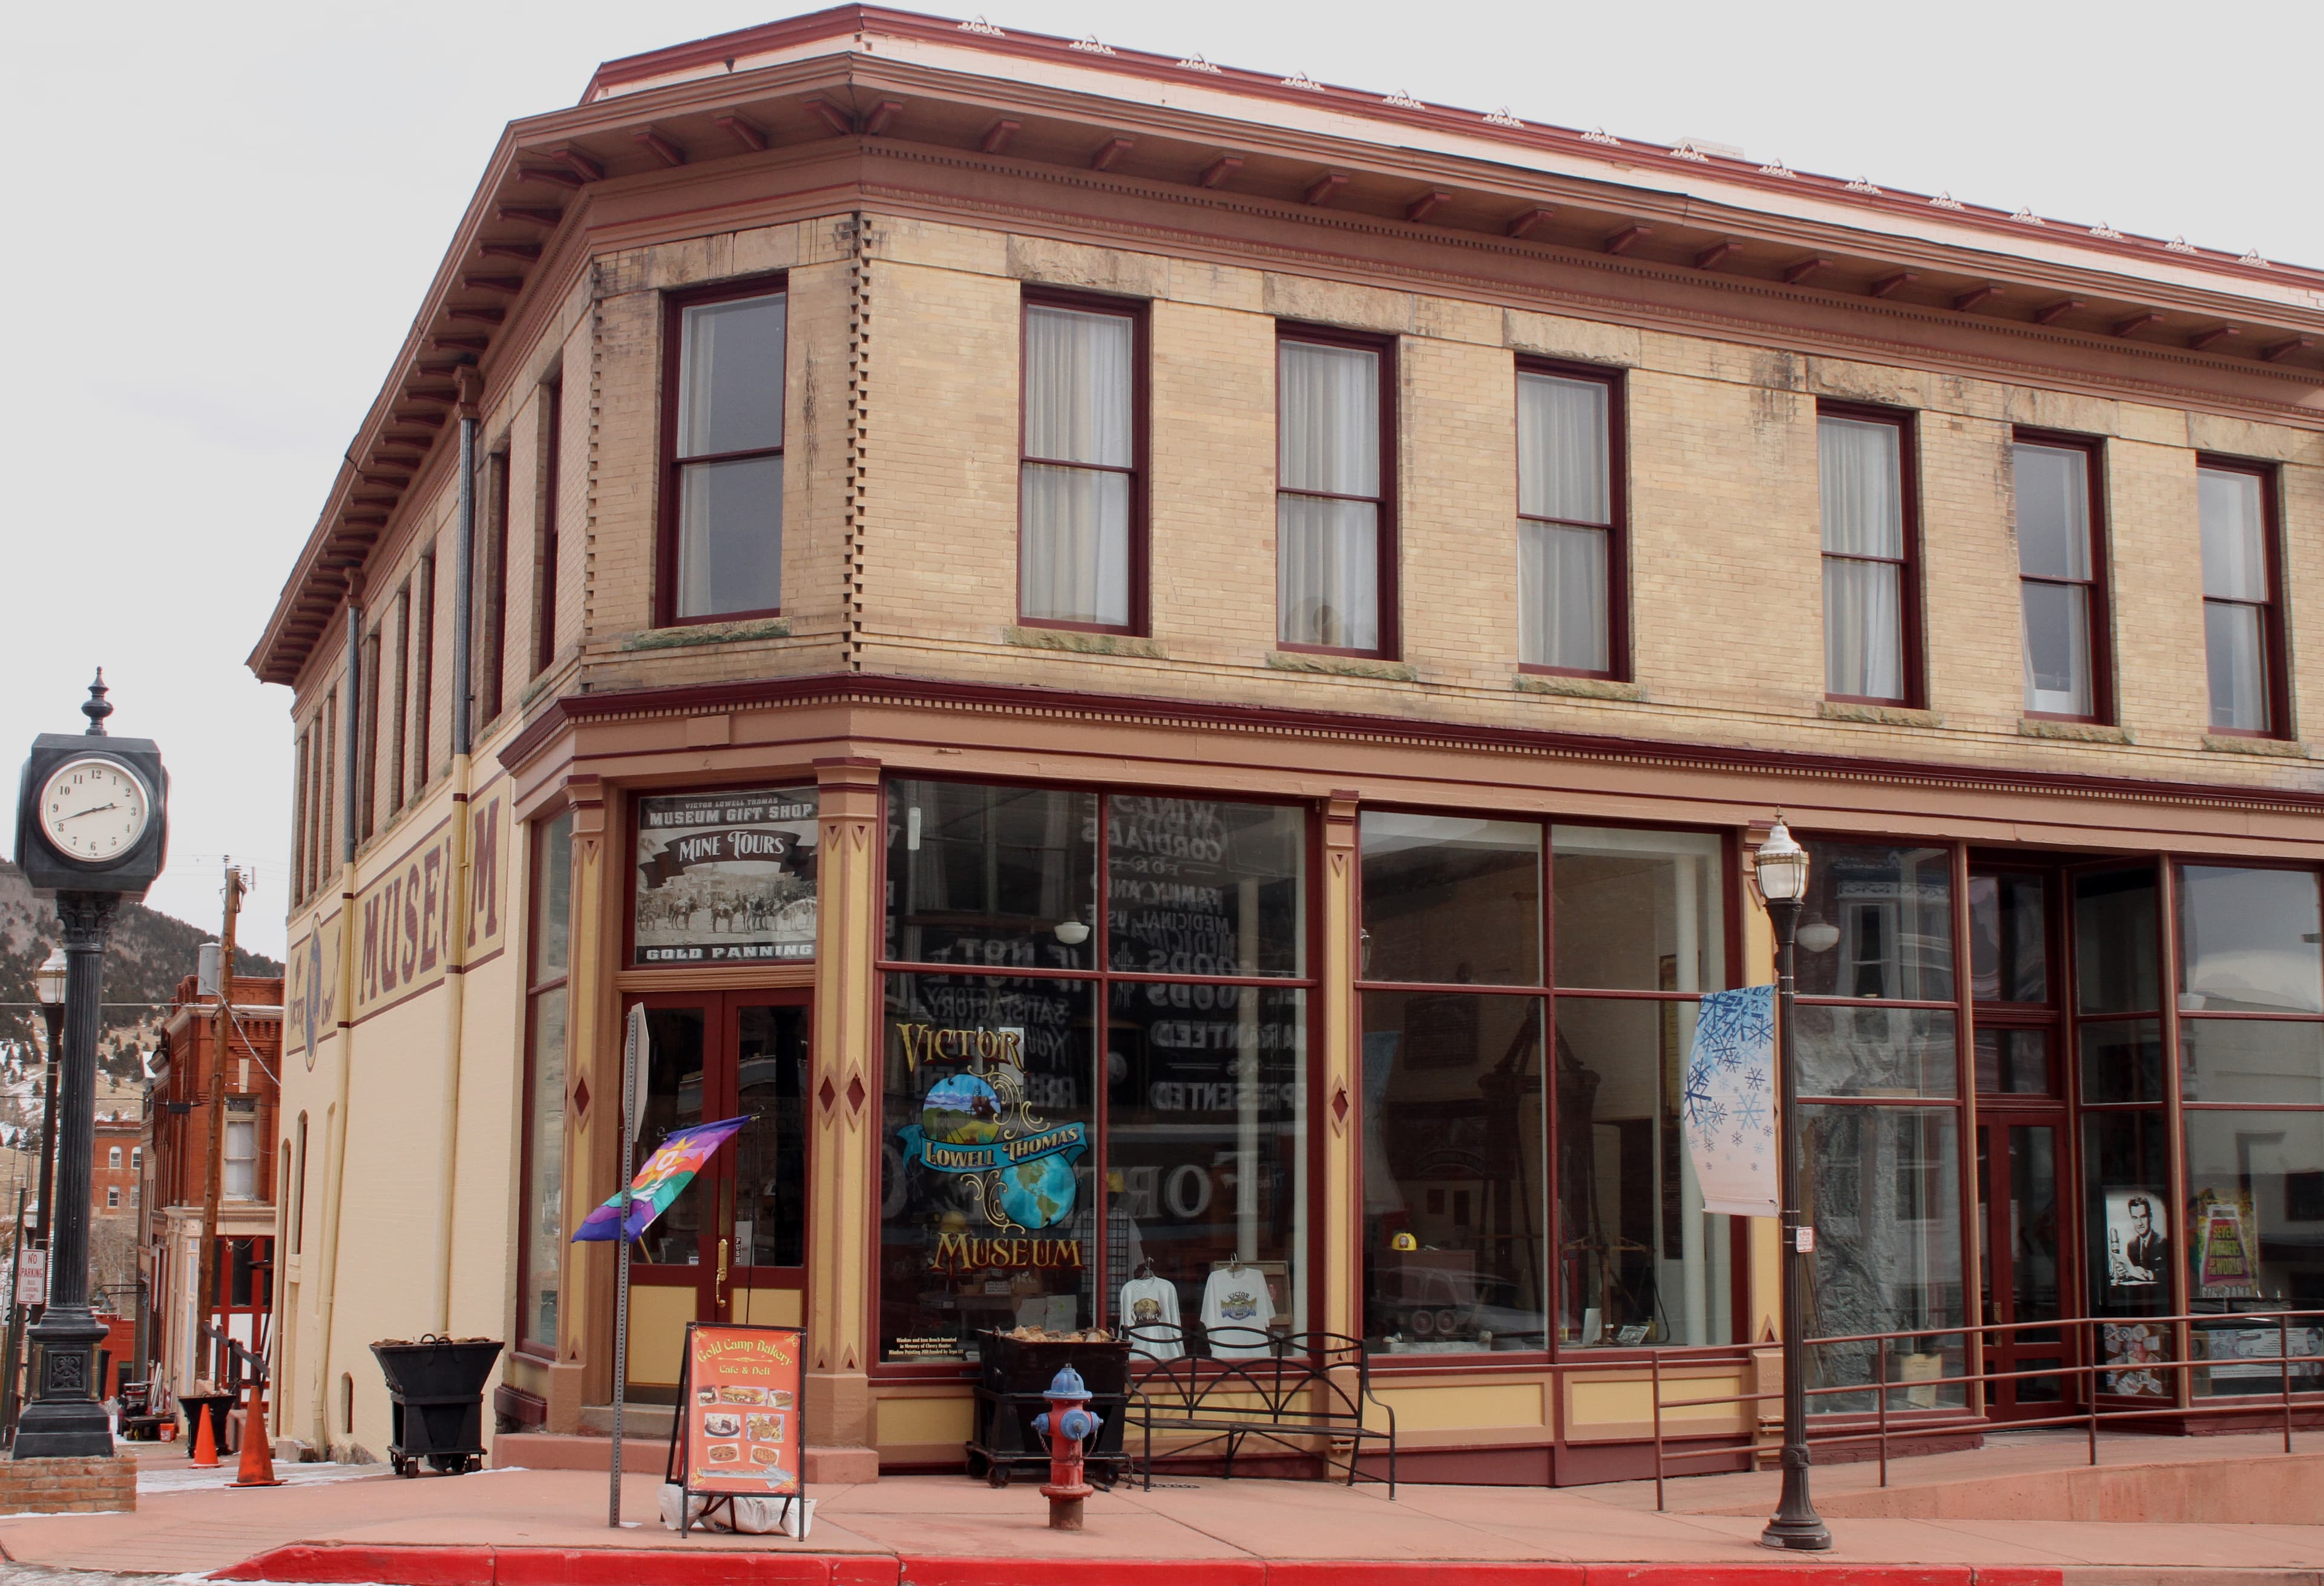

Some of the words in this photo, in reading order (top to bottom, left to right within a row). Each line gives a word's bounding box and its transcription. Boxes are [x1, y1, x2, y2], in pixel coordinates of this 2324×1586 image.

[73, 775, 84, 784] 11
[91, 770, 102, 779] 12
[113, 776, 117, 785] 1
[59, 785, 70, 796] 10
[125, 788, 131, 798] 2
[53, 803, 59, 813] 9
[131, 807, 137, 817] 3
[649, 809, 720, 826] MUSEUM
[726, 807, 763, 822] GIFT
[769, 804, 813, 818] SHOP
[58, 822, 64, 832] 8
[125, 824, 131, 833] 4
[72, 836, 77, 846] 7
[90, 841, 96, 851] 6
[111, 837, 117, 847] 5
[679, 836, 721, 862] MINE
[727, 831, 784, 859] TOURS
[646, 948, 703, 960] GOLD
[712, 944, 813, 958] PANNING
[896, 1023, 1027, 1073] VICTOR
[925, 1142, 997, 1168] LOWELL
[1002, 1127, 1078, 1162] THOMAS
[2213, 1225, 2236, 1239] SEVEN
[930, 1233, 1086, 1271] MUSEUM
[28, 1254, 38, 1264] NO
[21, 1268, 42, 1278] PARKING
[697, 1340, 722, 1363] Gold
[724, 1338, 753, 1352] Camp
[757, 1339, 793, 1366] Bakery
[719, 1365, 738, 1374] Cafe
[752, 1366, 770, 1375] Deli
